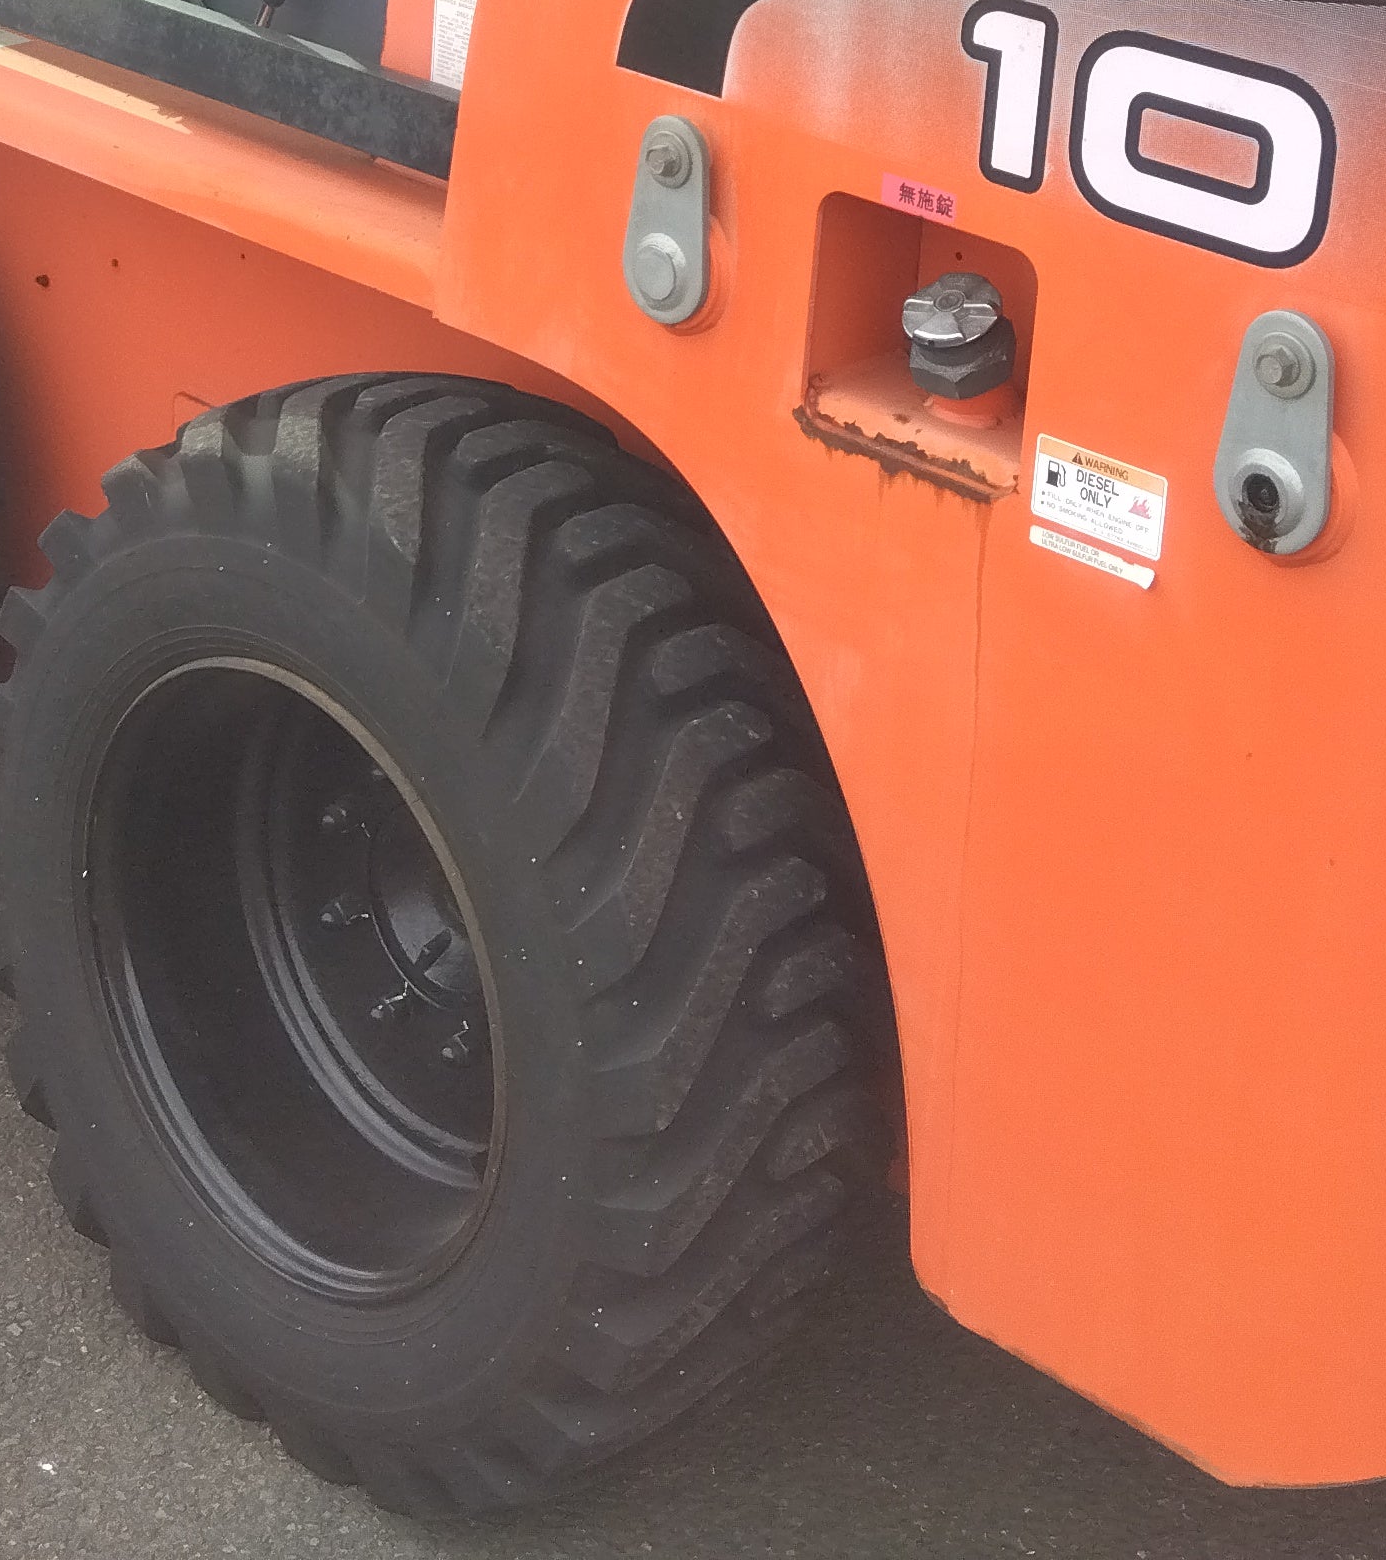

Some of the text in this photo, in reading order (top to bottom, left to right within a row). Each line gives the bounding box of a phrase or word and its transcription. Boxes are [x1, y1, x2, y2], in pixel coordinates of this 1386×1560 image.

[898, 182, 954, 218] 無施錠
[1085, 455, 1129, 481] WARNING
[1076, 469, 1120, 497] DIESEL
[1080, 487, 1112, 509] ONLY
[1091, 518, 1124, 535] ALLOWED
